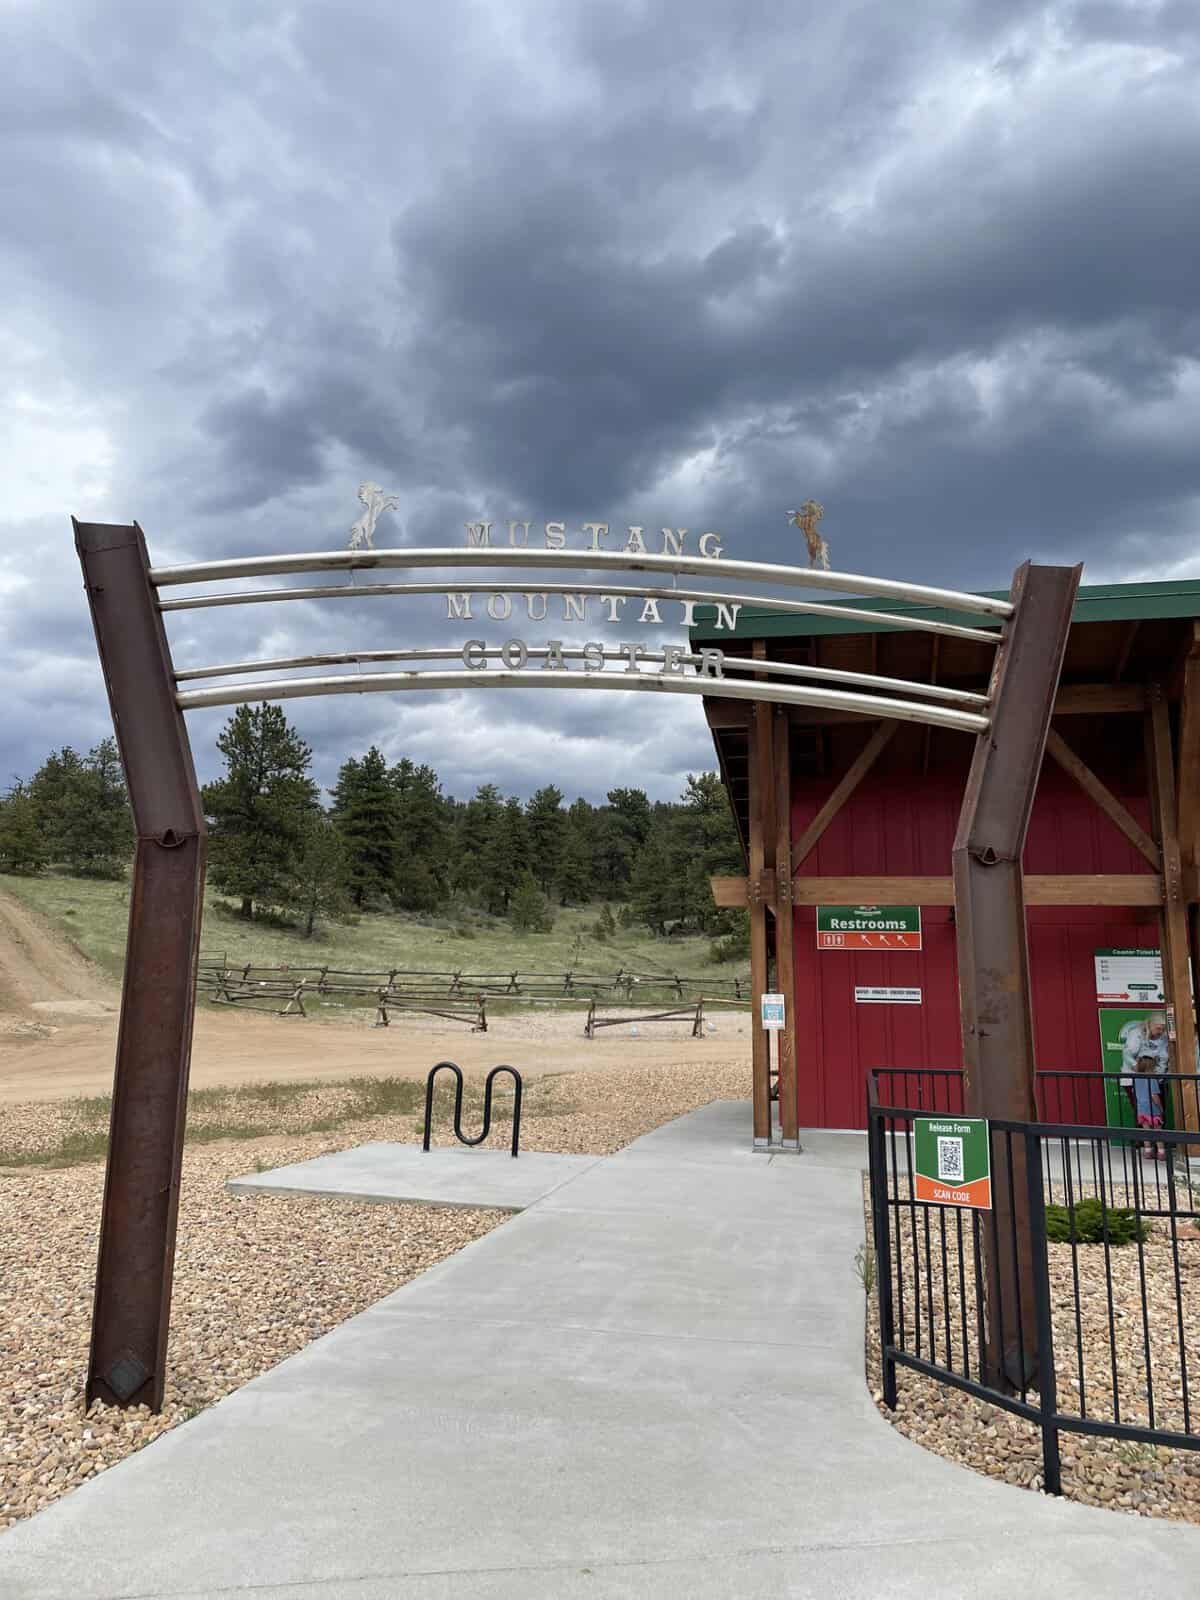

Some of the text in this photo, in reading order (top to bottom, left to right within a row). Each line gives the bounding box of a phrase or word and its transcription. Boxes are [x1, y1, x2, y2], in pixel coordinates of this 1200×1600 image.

[465, 521, 724, 560] MUSTANG
[446, 592, 742, 631] MOUNTAIN
[462, 638, 725, 679] COASTER
[830, 918, 907, 930] Restrooms
[929, 1122, 971, 1133] Release Form
[933, 1189, 971, 1202] SCAN CODE
